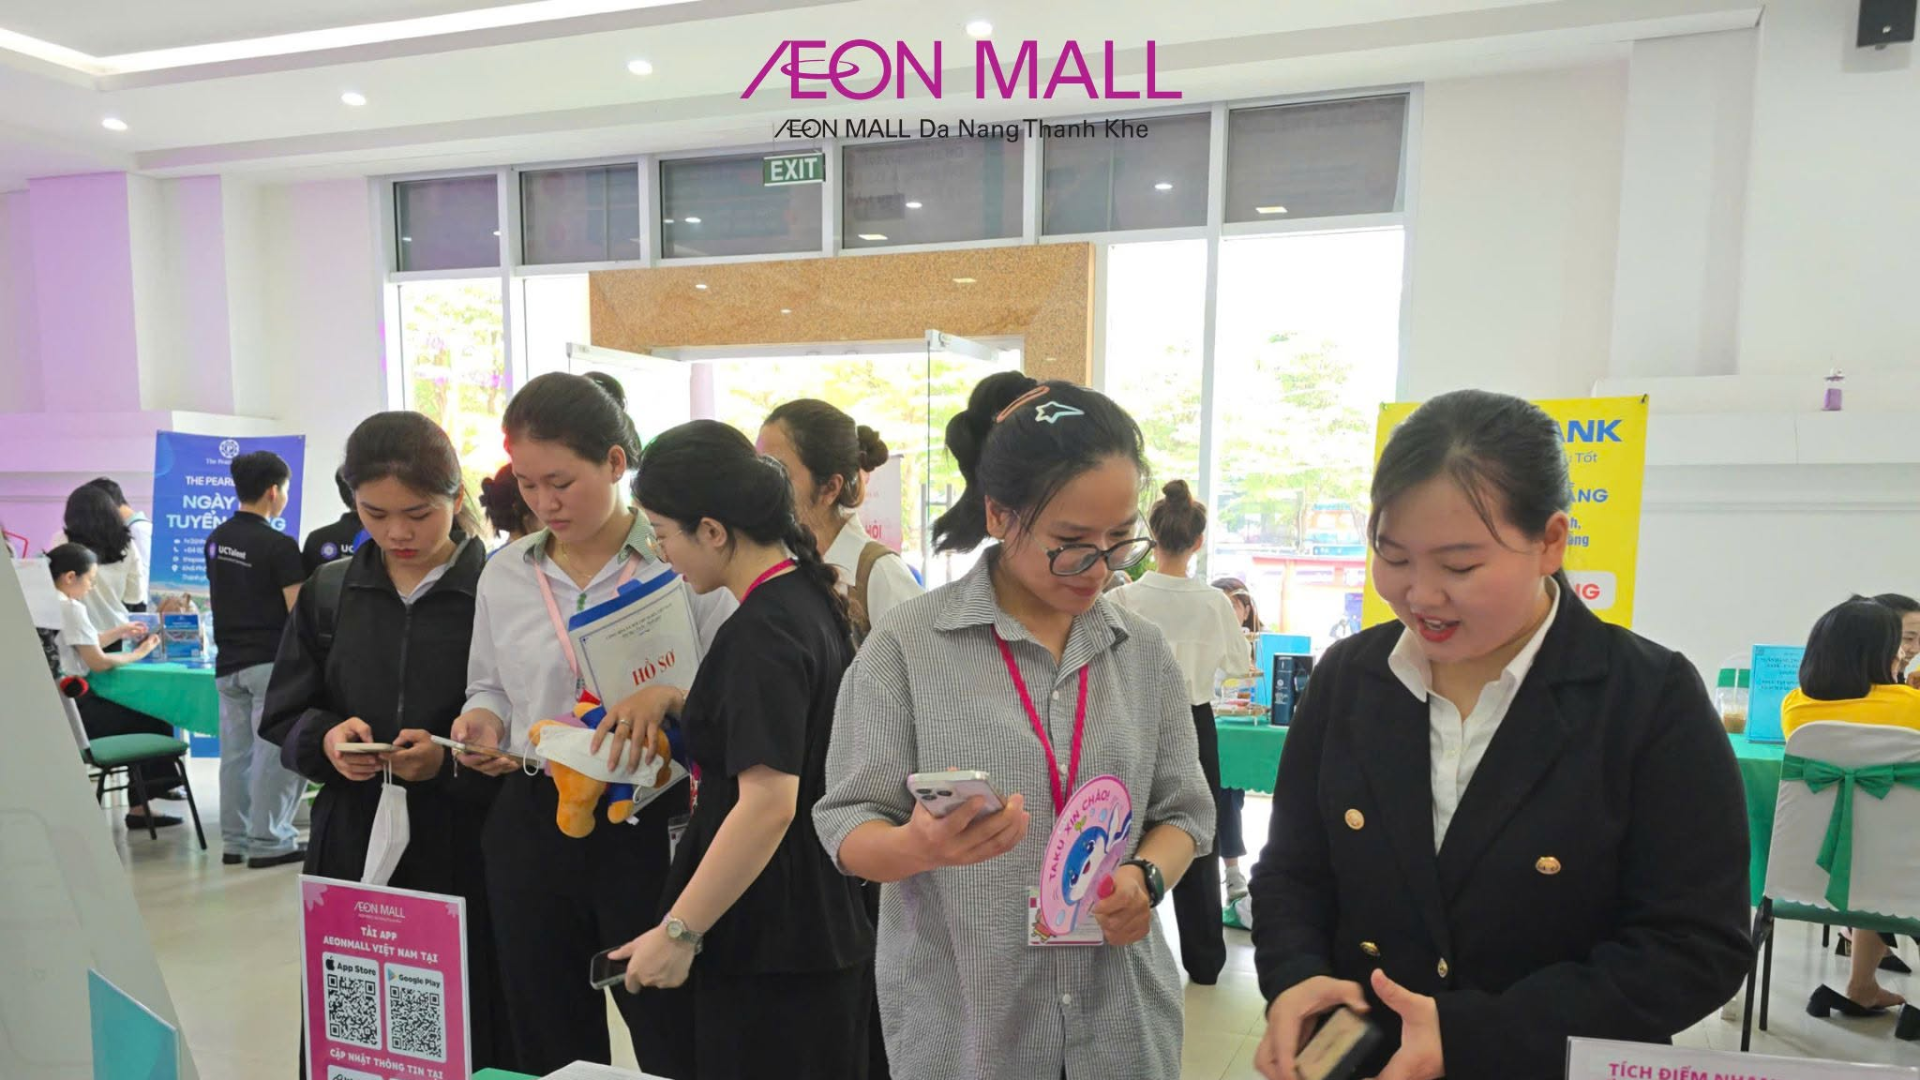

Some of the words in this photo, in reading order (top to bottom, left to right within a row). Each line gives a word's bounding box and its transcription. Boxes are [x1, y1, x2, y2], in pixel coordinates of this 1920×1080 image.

[771, 157, 818, 181] EXIT
[1560, 419, 1622, 443] NK
[185, 475, 205, 486] THE
[183, 493, 236, 510] NGÀY
[218, 545, 248, 559] UCTalent
[631, 657, 657, 686] HỒ
[1065, 809, 1080, 836] XIN
[380, 903, 405, 919] MALL
[379, 930, 398, 942] APP
[323, 935, 371, 952] AEONMALL
[372, 942, 395, 957] VIỆT
[397, 948, 418, 960] NAM
[420, 951, 439, 965] TẠI
[337, 962, 353, 973] App
[354, 965, 377, 976] Store
[398, 973, 424, 986] Google
[424, 977, 441, 989] Play
[329, 1048, 346, 1061] CẬP
[347, 1053, 371, 1067] NHẬT
[373, 1057, 405, 1072] THÔNG
[407, 1064, 425, 1076] TIN
[1608, 1060, 1653, 1079] TÍCH
